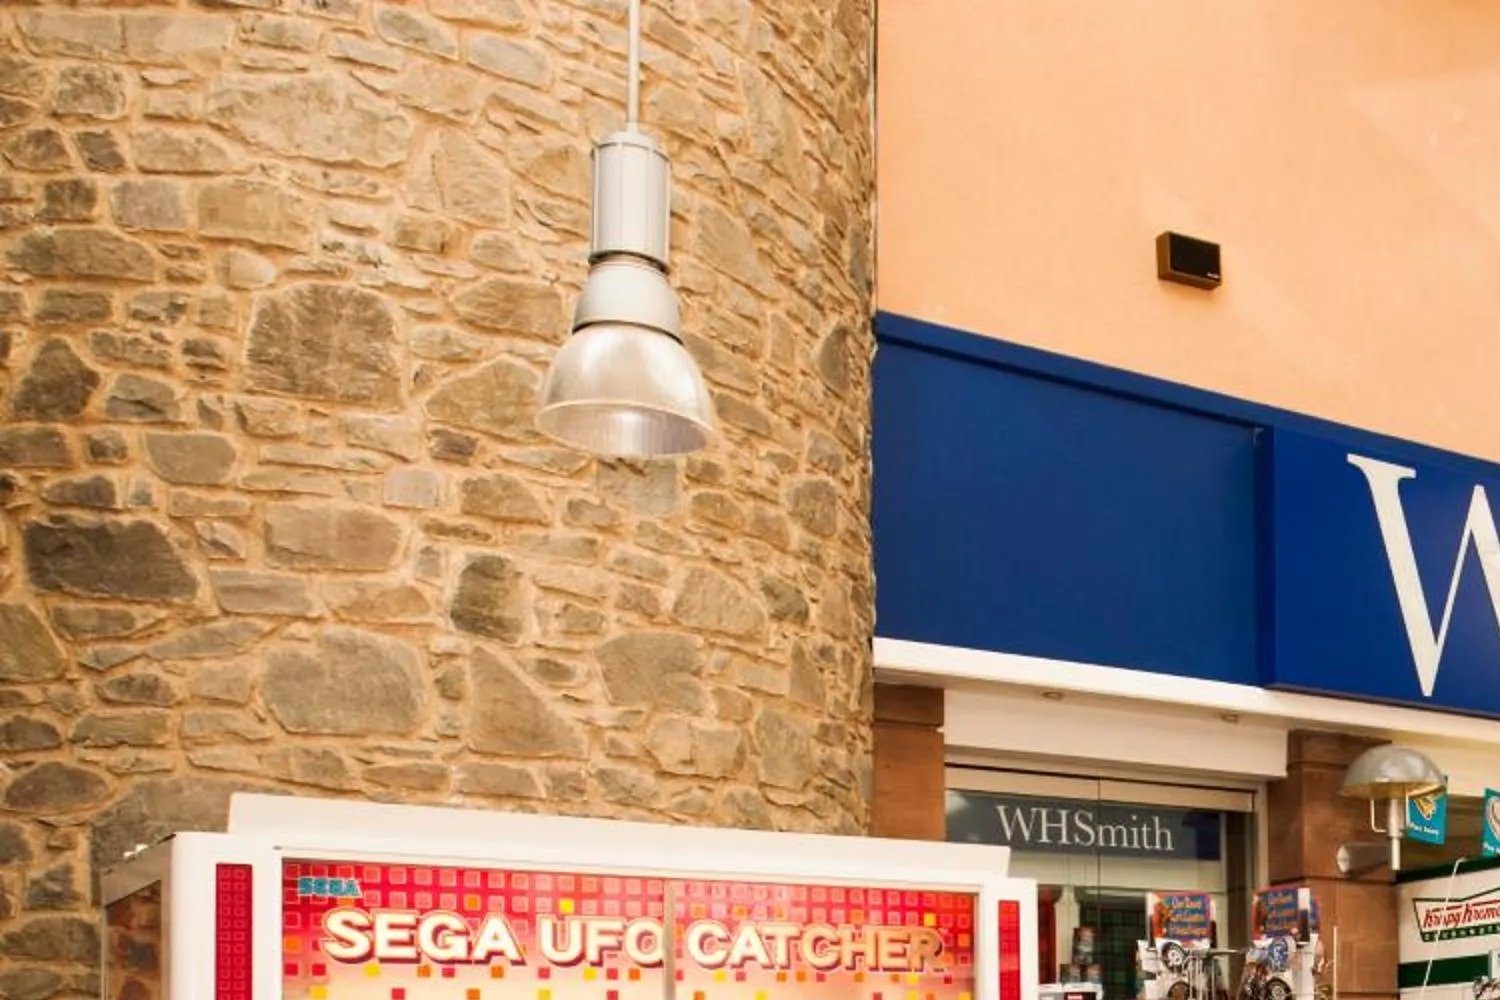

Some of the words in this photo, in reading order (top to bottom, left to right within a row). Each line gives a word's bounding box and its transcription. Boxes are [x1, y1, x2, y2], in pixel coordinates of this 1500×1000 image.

[997, 804, 1175, 852] WHSmith
[298, 877, 361, 897] SEGA
[321, 907, 526, 965] SEGA
[536, 915, 664, 967] UFO
[686, 920, 946, 972] CATCHER
